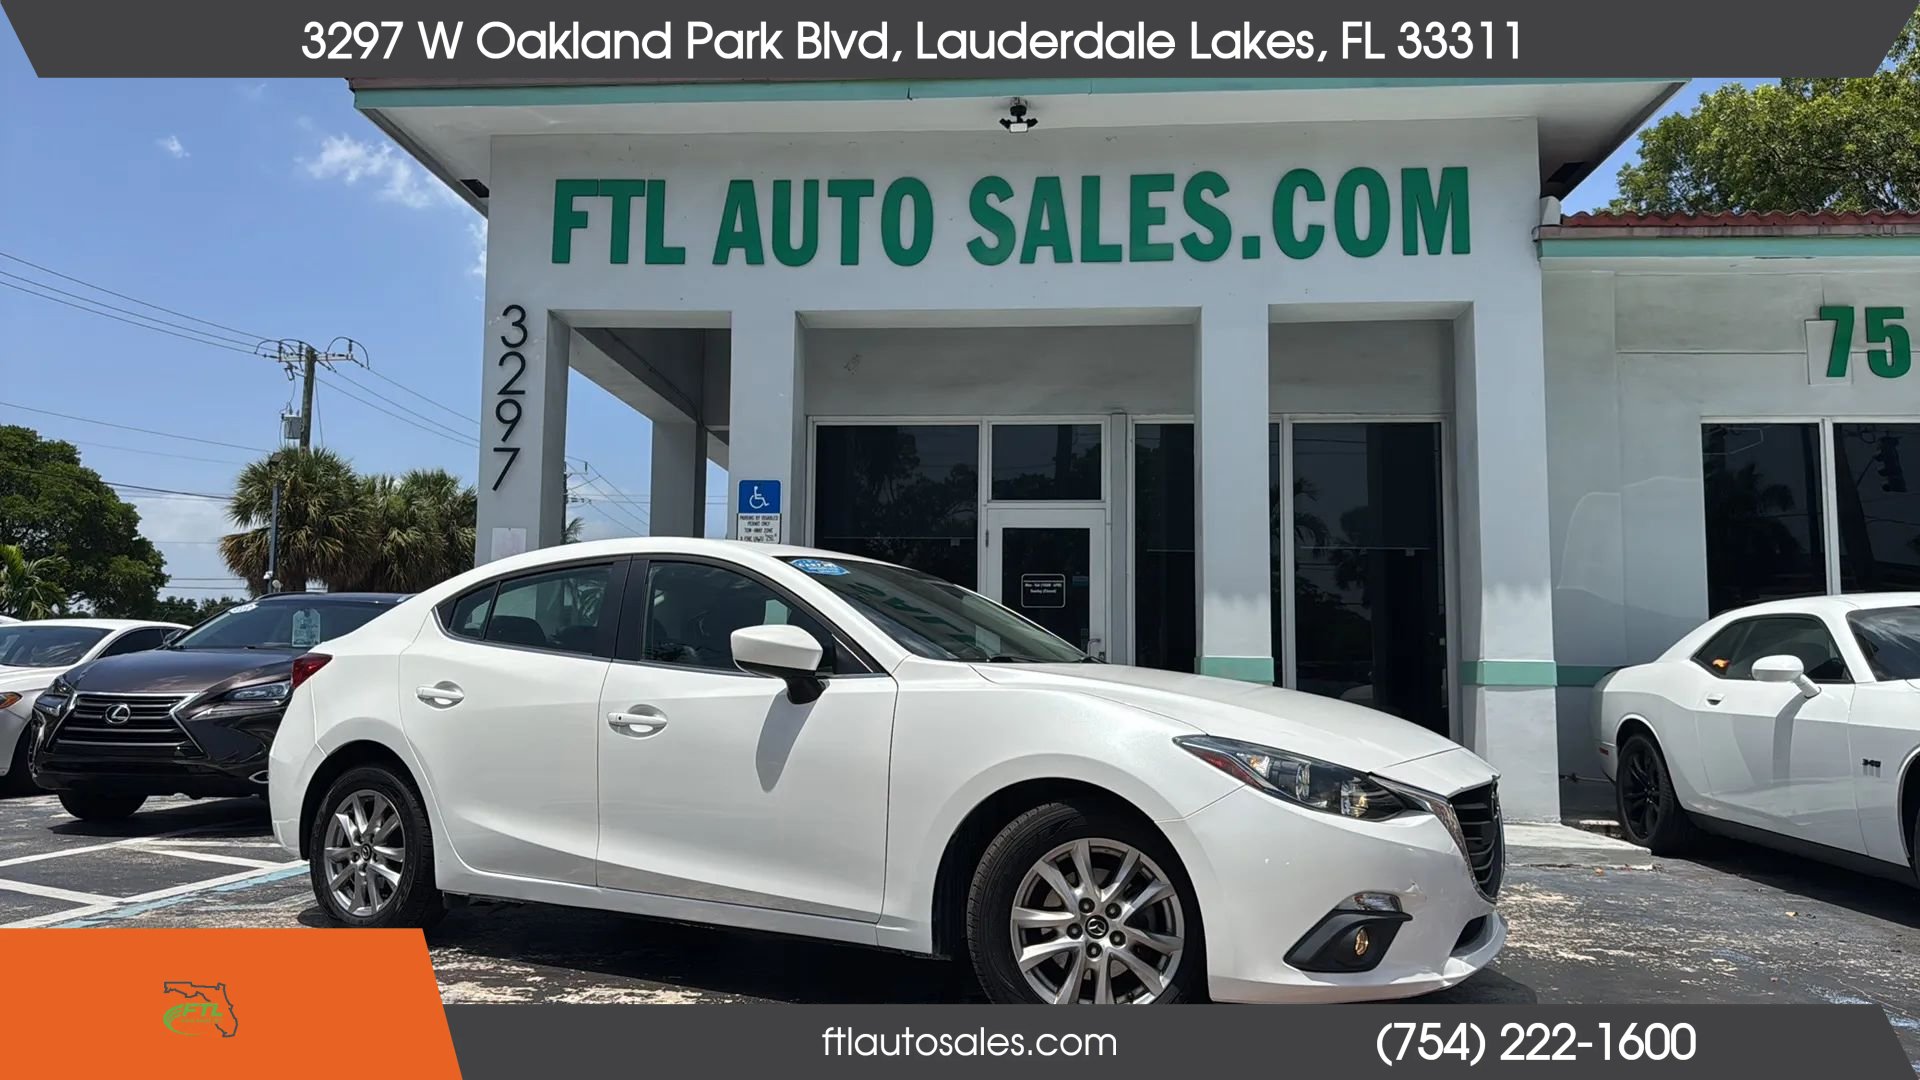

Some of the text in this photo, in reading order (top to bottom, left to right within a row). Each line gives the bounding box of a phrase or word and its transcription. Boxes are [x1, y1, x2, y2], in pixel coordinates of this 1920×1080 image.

[552, 167, 1472, 267] FTL AUTO SALES.COM
[1820, 305, 1912, 379] 75
[492, 303, 529, 493] 3297
